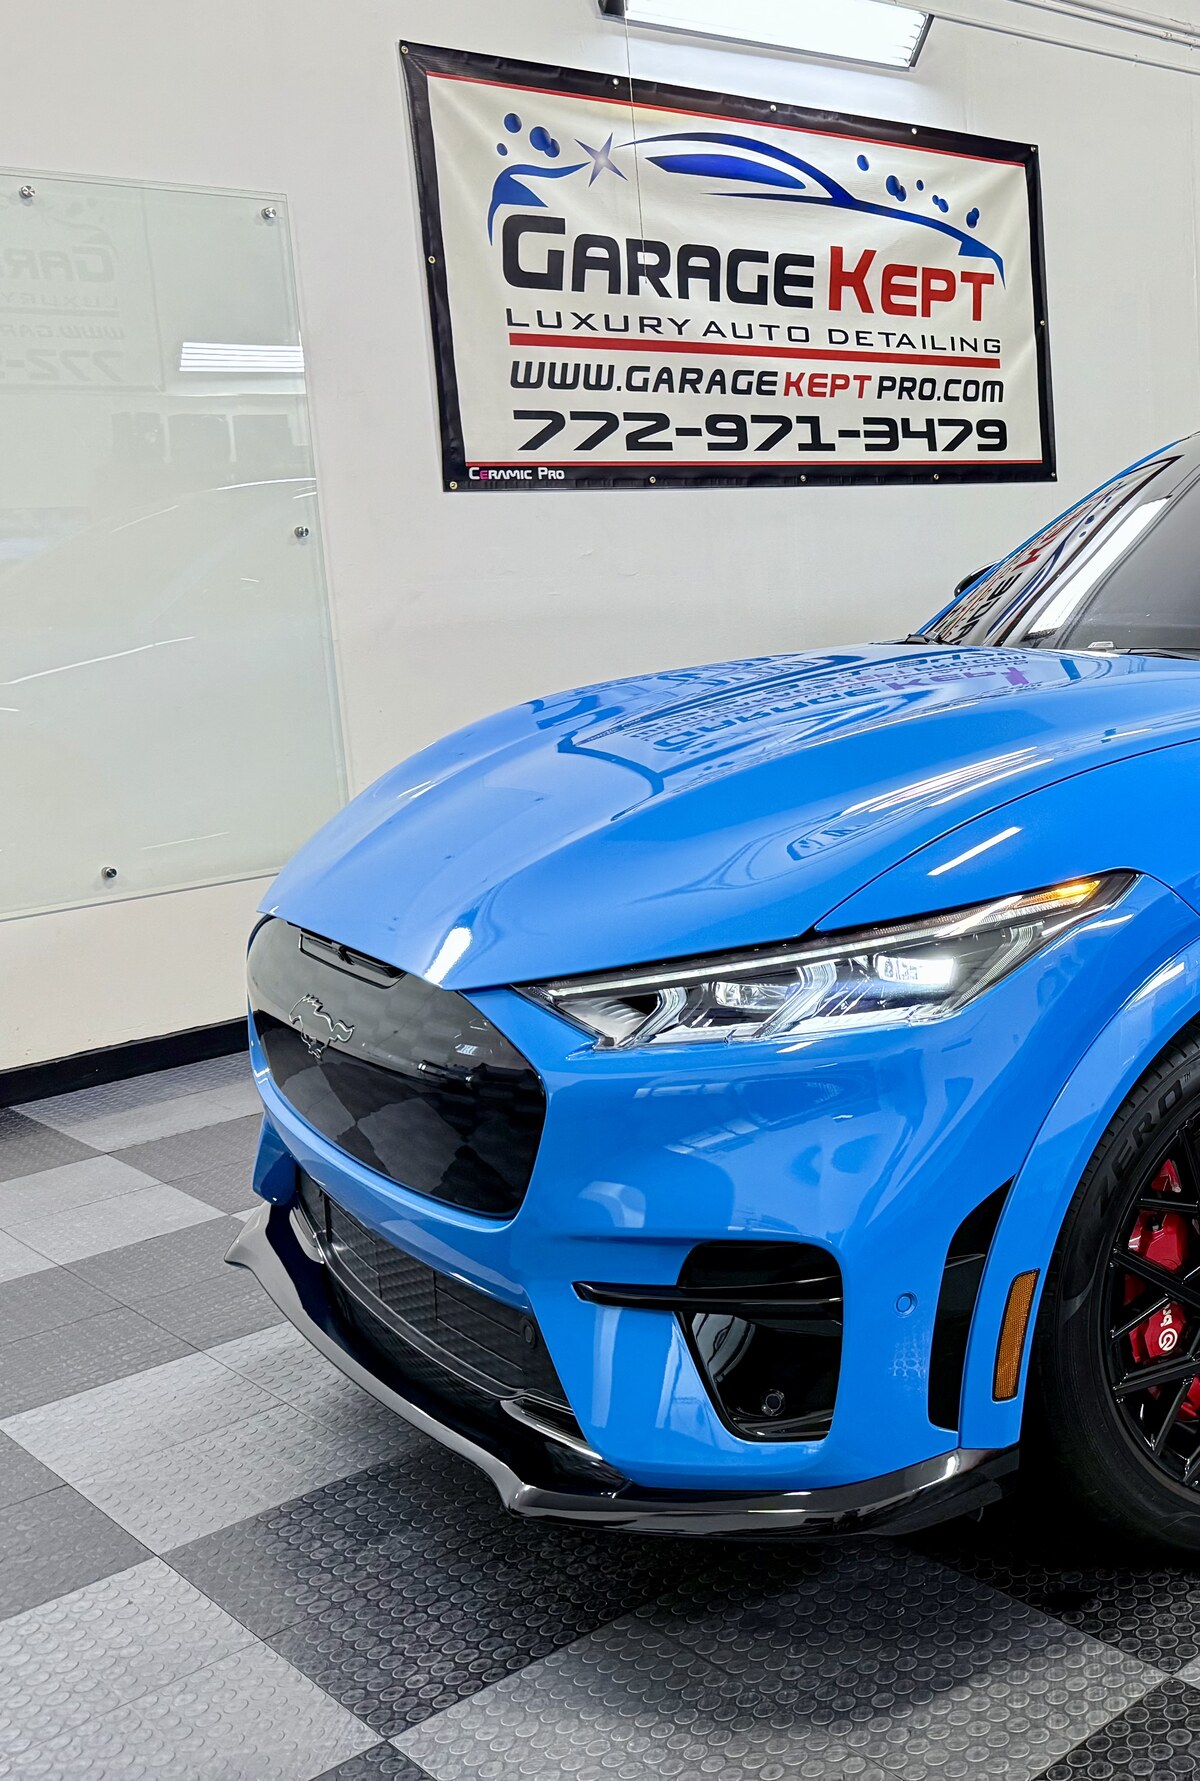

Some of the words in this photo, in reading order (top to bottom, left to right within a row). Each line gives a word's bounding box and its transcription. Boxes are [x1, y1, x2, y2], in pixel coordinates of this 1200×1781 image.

[502, 214, 815, 309] GARAGE
[828, 245, 995, 322] KEPT
[506, 308, 691, 336] LUXURY
[702, 320, 810, 343] AUTO
[828, 328, 1001, 353] DETAILING
[513, 410, 1008, 452] 772-971-3479
[468, 467, 532, 480] CERAMIC
[537, 467, 565, 480] PRO
